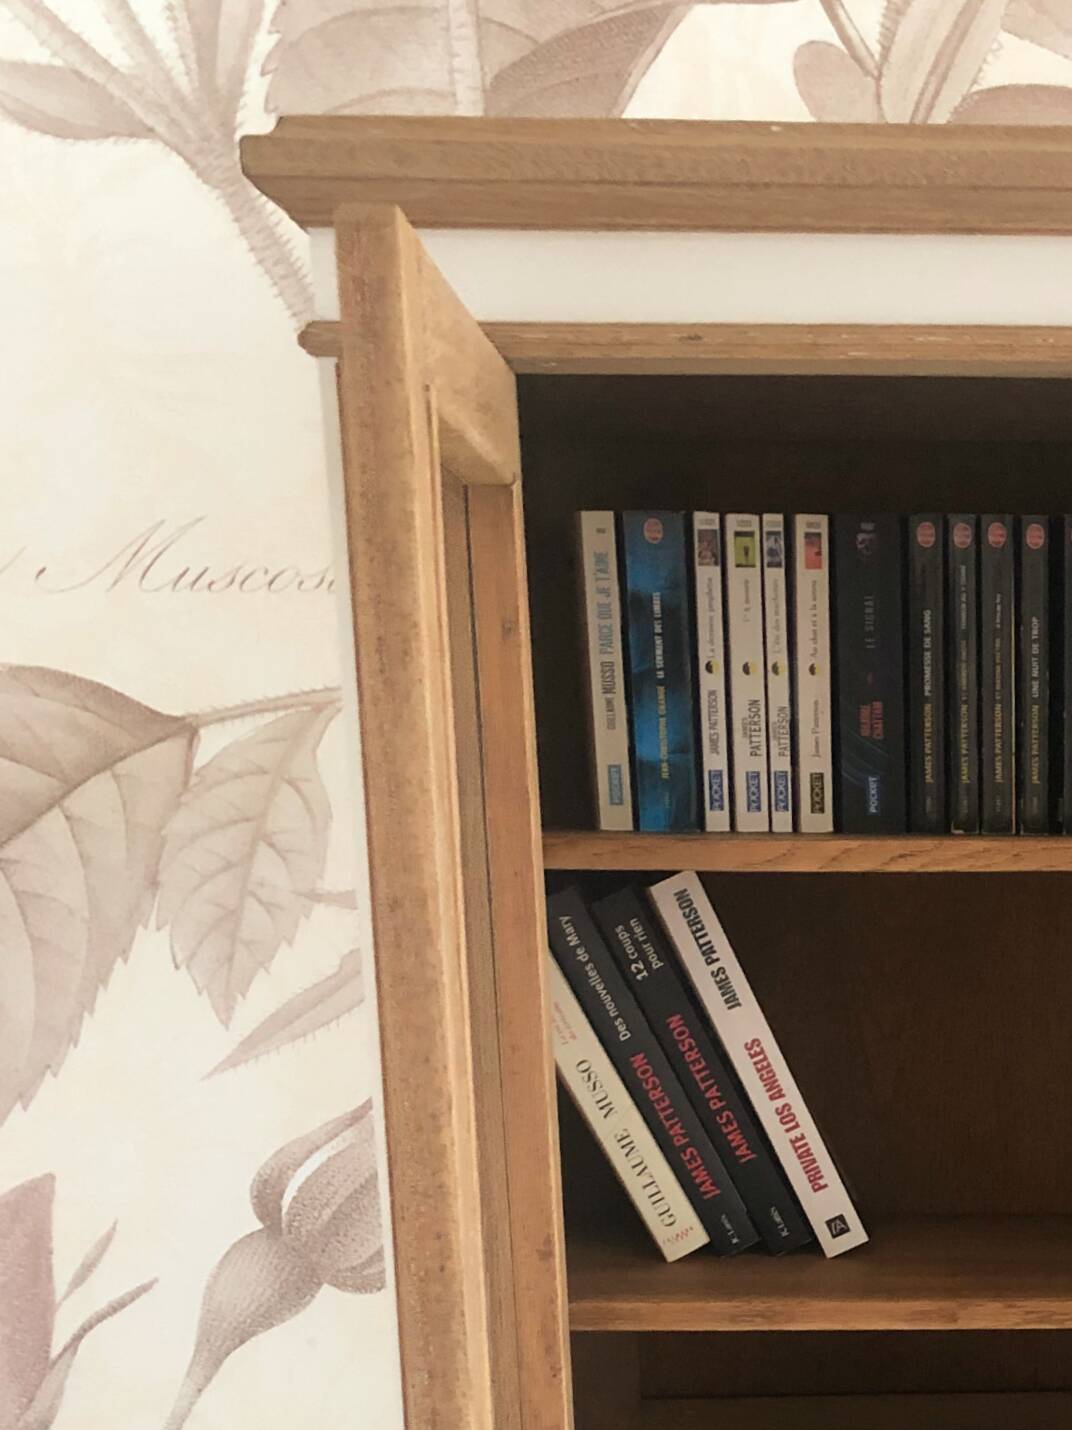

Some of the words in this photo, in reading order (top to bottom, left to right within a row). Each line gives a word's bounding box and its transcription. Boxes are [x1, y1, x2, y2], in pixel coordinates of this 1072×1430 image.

[596, 587, 610, 597] JE
[597, 602, 611, 619] QUE
[598, 624, 613, 654] PARCE
[653, 620, 662, 633] DES
[923, 609, 931, 634] SANG
[923, 637, 931, 648] DE
[1032, 643, 1039, 654] DE
[600, 661, 616, 694] MUSSO
[923, 650, 932, 696] PROMESSE
[708, 690, 718, 730] PATTERSON
[748, 699, 762, 757] PATTERSON
[924, 704, 933, 753] PATTERSON
[994, 704, 1002, 753] PATTERSON
[709, 732, 720, 755] JAMES
[777, 706, 788, 757] PATTERSON
[812, 736, 822, 758] James
[960, 704, 969, 754] PATTERSON
[924, 755, 934, 782] JAMES
[960, 757, 969, 783] JAMES
[995, 756, 1003, 783] JAMES
[1032, 756, 1040, 784] JAMES
[710, 770, 723, 810] POCKET
[748, 771, 760, 811] POCKET
[776, 771, 788, 811] POCKET
[812, 773, 823, 812] POCKET
[868, 776, 878, 813] POCKET
[559, 915, 581, 947] Mary
[614, 924, 639, 960] coups
[629, 917, 650, 944] rien
[673, 888, 721, 966] PATTERSON
[575, 946, 589, 962] de
[630, 959, 649, 981] 12
[644, 944, 665, 970] pour
[583, 962, 619, 1020] nouvelles
[710, 966, 743, 1010] JAMES
[614, 1017, 631, 1042] Des
[665, 1013, 727, 1110] PATTERSON
[744, 1038, 786, 1102] ANGELES
[575, 1058, 617, 1120] MUSSO
[630, 1052, 690, 1147] PATTERSON
[774, 1102, 801, 1133] LOS
[715, 1110, 758, 1164] JAMES
[614, 1128, 677, 1227] GUILLAUME
[680, 1146, 721, 1200] JAMES
[788, 1132, 829, 1193] PRIVATE
